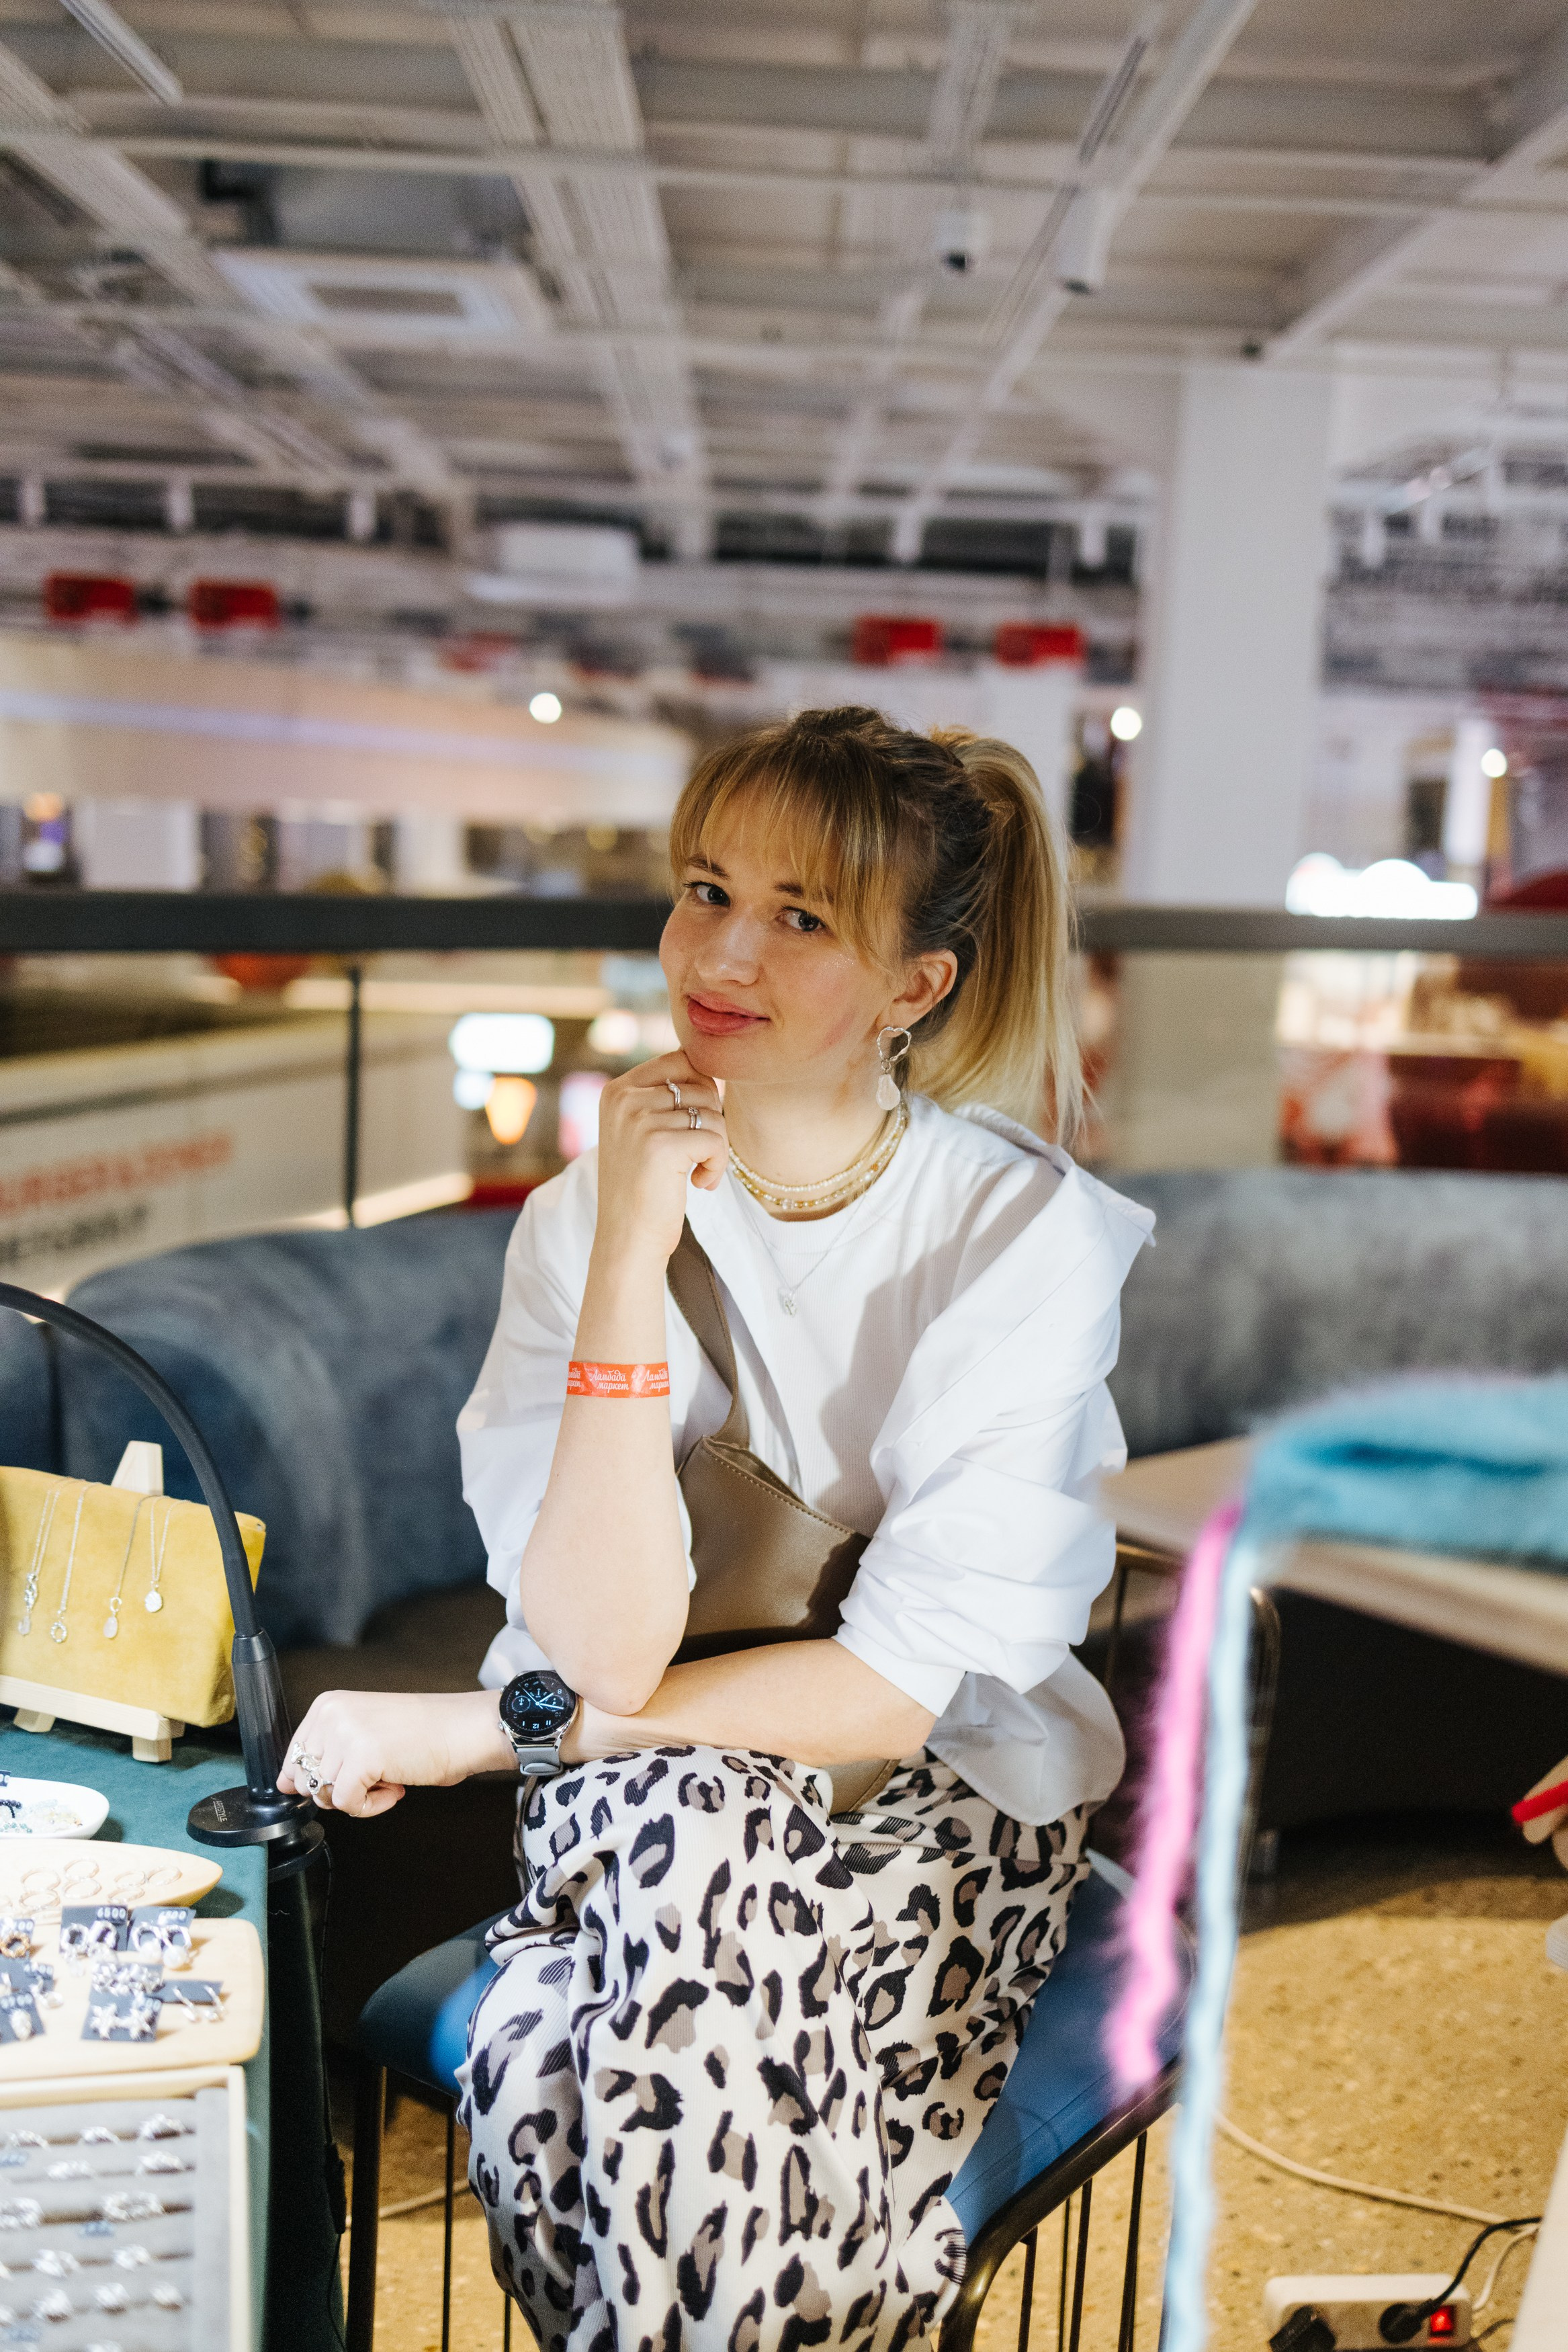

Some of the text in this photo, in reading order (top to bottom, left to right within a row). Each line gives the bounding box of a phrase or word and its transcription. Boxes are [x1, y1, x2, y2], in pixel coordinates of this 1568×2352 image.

[589, 1369, 627, 1382] Ламбада
[597, 1382, 629, 1393] маркет
[215, 1800, 228, 1822] ARTSTYLE
